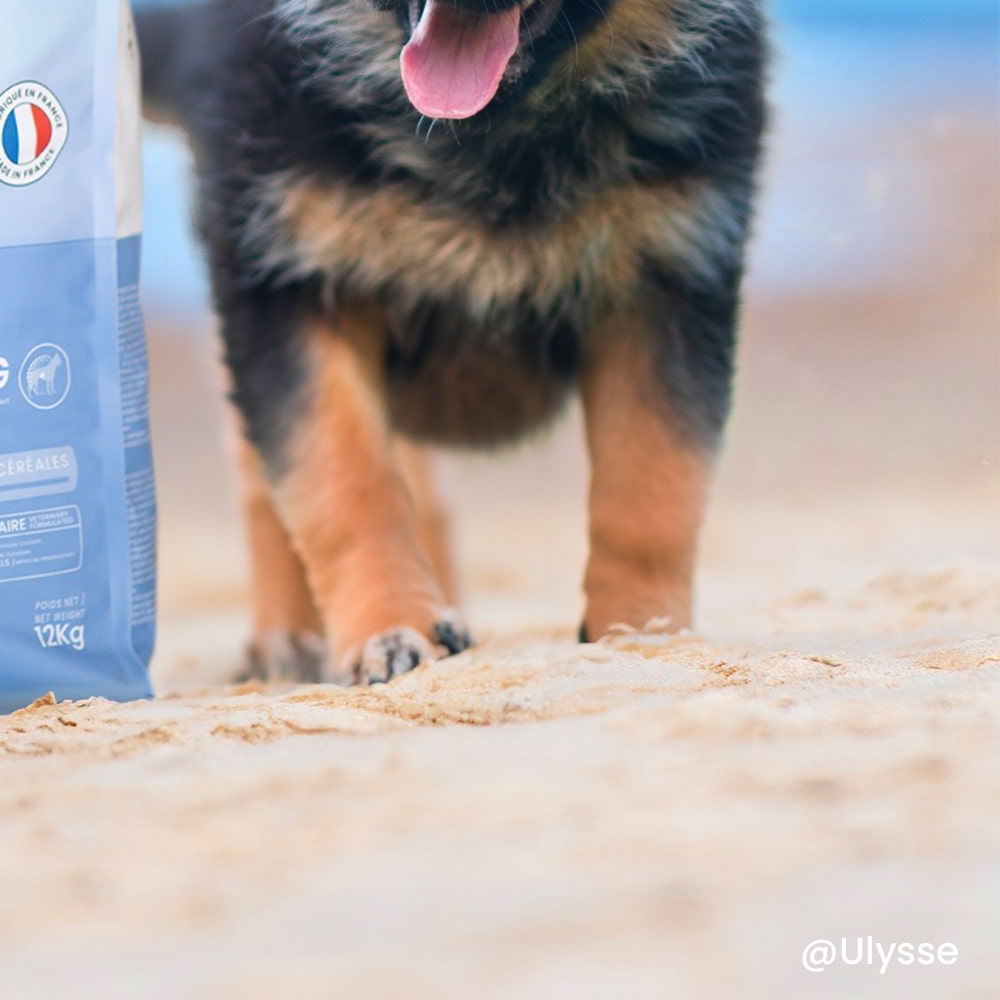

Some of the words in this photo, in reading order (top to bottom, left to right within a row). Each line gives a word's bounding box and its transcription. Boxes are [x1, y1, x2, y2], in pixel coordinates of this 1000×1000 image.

[37, 91, 63, 129] FRANCE
[23, 148, 55, 178] FRANCE
[34, 623, 85, 650] 12Kg
